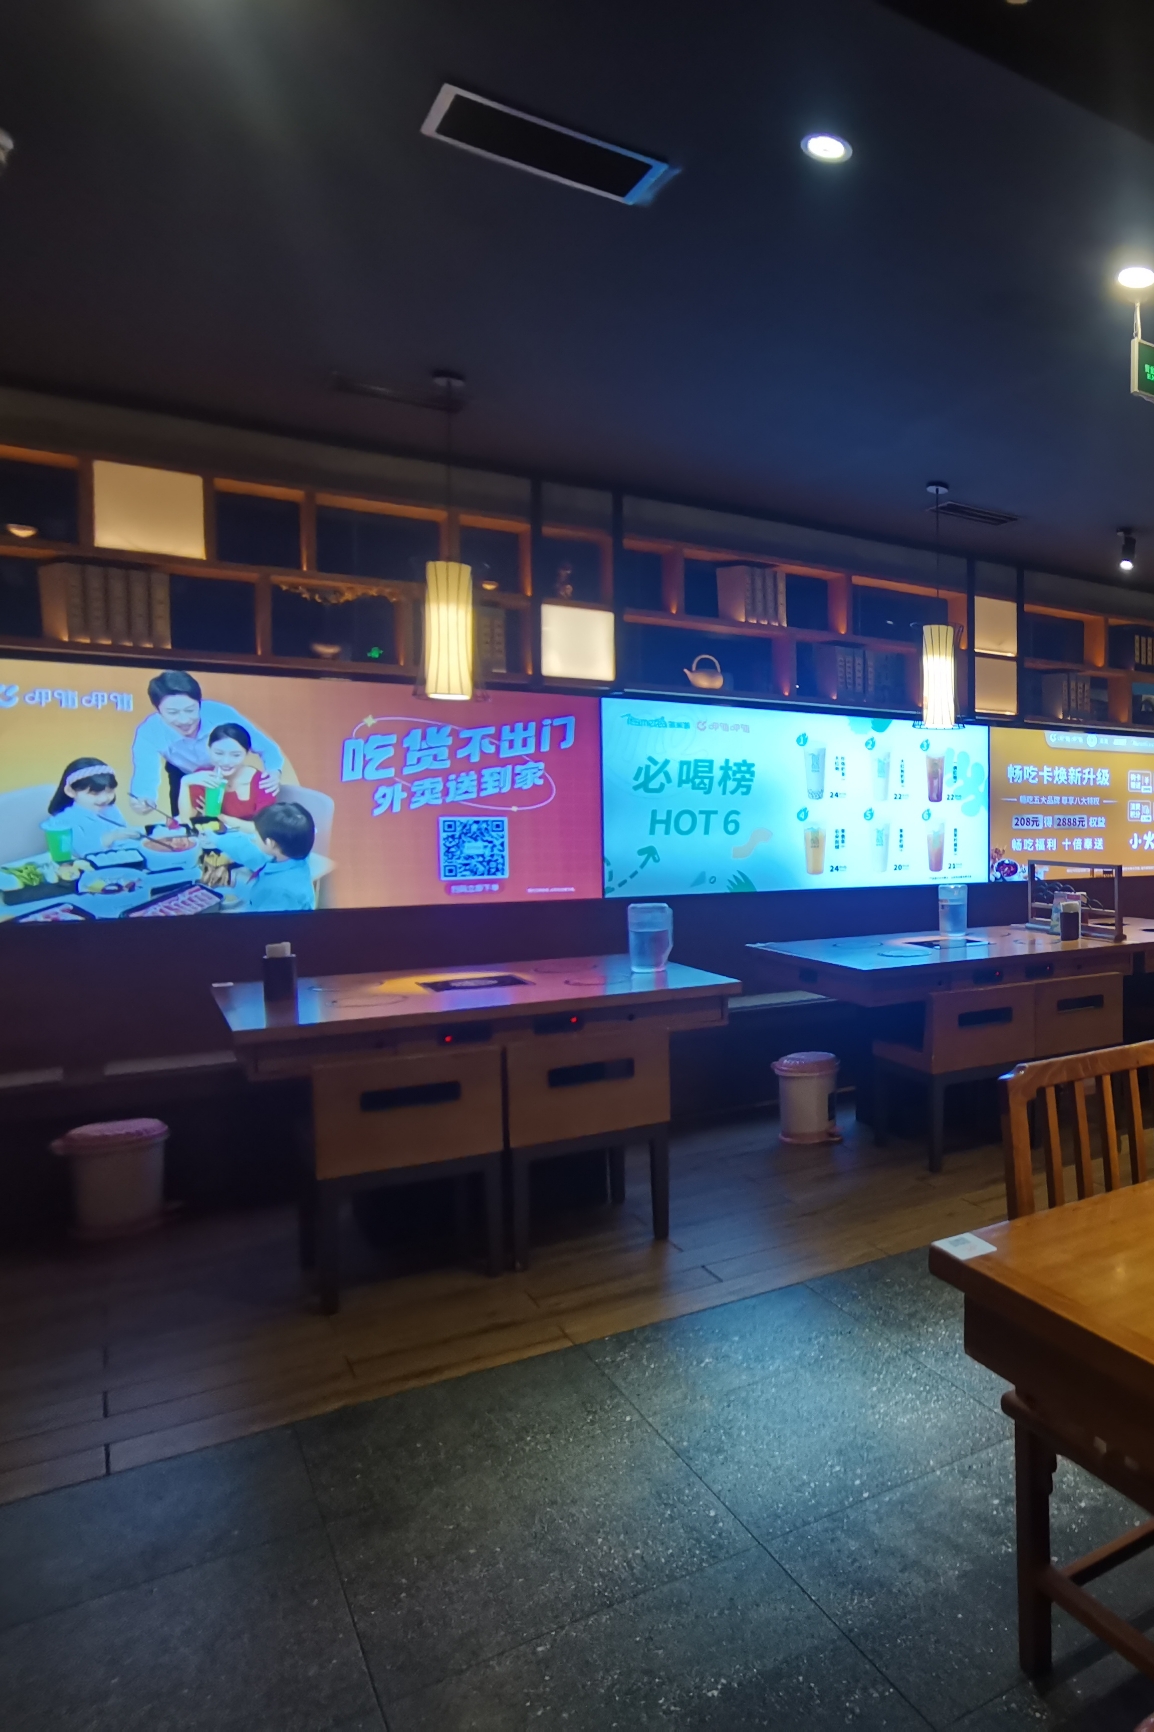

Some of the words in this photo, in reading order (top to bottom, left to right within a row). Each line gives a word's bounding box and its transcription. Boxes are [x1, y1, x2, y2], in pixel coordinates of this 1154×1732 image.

[341, 714, 578, 782] 吃货不出门
[631, 755, 756, 796] 必喝榜
[1007, 764, 1110, 786] 畅吃卡焕新升级
[371, 761, 545, 817] 外卖送到家
[829, 791, 840, 799] 24
[648, 808, 718, 836] HOT
[722, 809, 742, 836] 6
[1013, 816, 1040, 828] 208元
[1056, 817, 1086, 828] 2888元
[1011, 838, 1057, 851] 畅吃福利
[829, 865, 840, 873] 24
